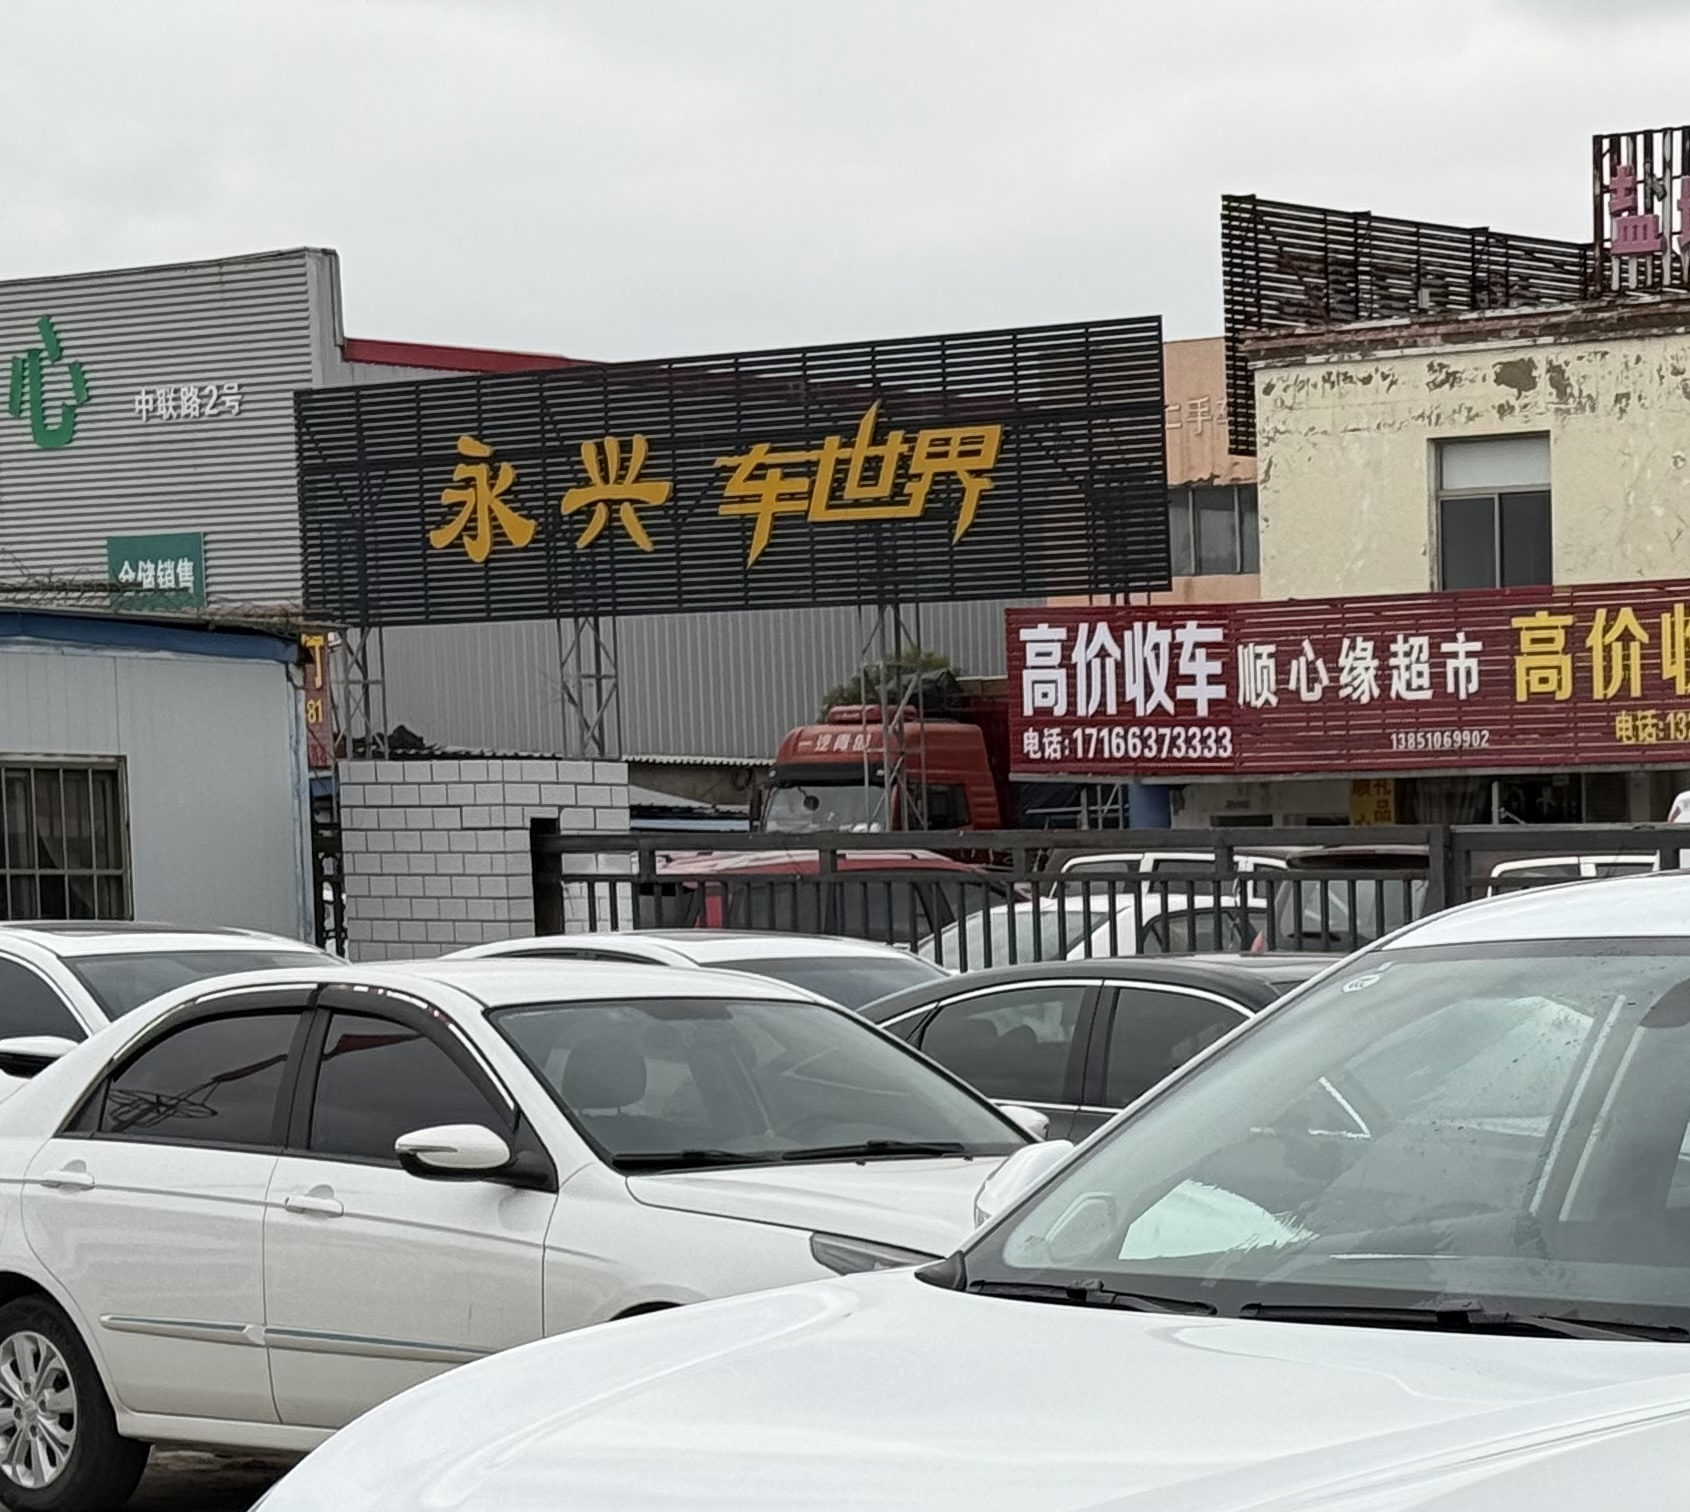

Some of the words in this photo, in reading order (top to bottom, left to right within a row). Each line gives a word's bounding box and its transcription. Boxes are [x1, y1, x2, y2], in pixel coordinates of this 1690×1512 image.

[134, 382, 243, 423] 中联路2号
[429, 399, 1003, 569] 永兴车世界
[1019, 620, 1228, 718] 高价收车
[1237, 632, 1484, 708] 顺心缘超市
[1390, 729, 1490, 750] 13851069902
